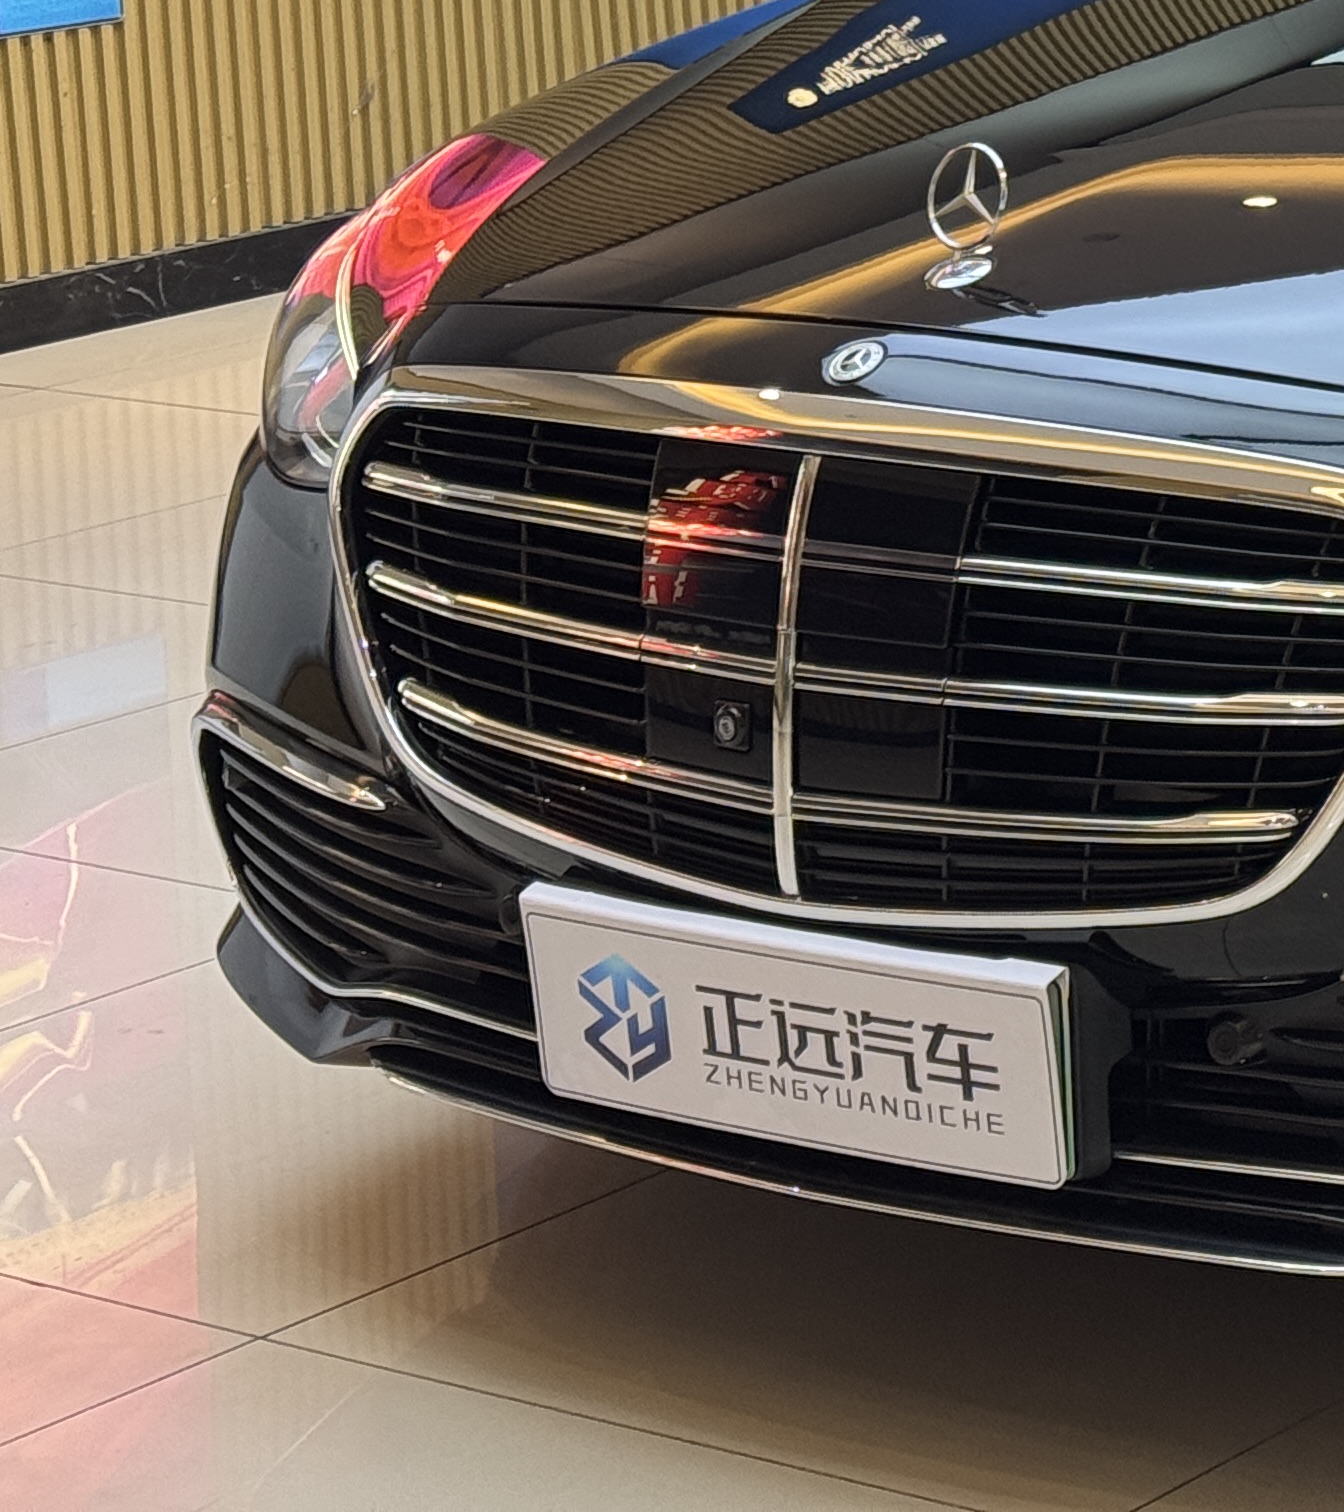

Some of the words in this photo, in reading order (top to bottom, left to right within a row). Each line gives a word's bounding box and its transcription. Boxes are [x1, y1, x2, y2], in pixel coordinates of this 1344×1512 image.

[695, 984, 1001, 1102] 正远汽车
[703, 1062, 1006, 1136] ZHENGYUANQICHE
